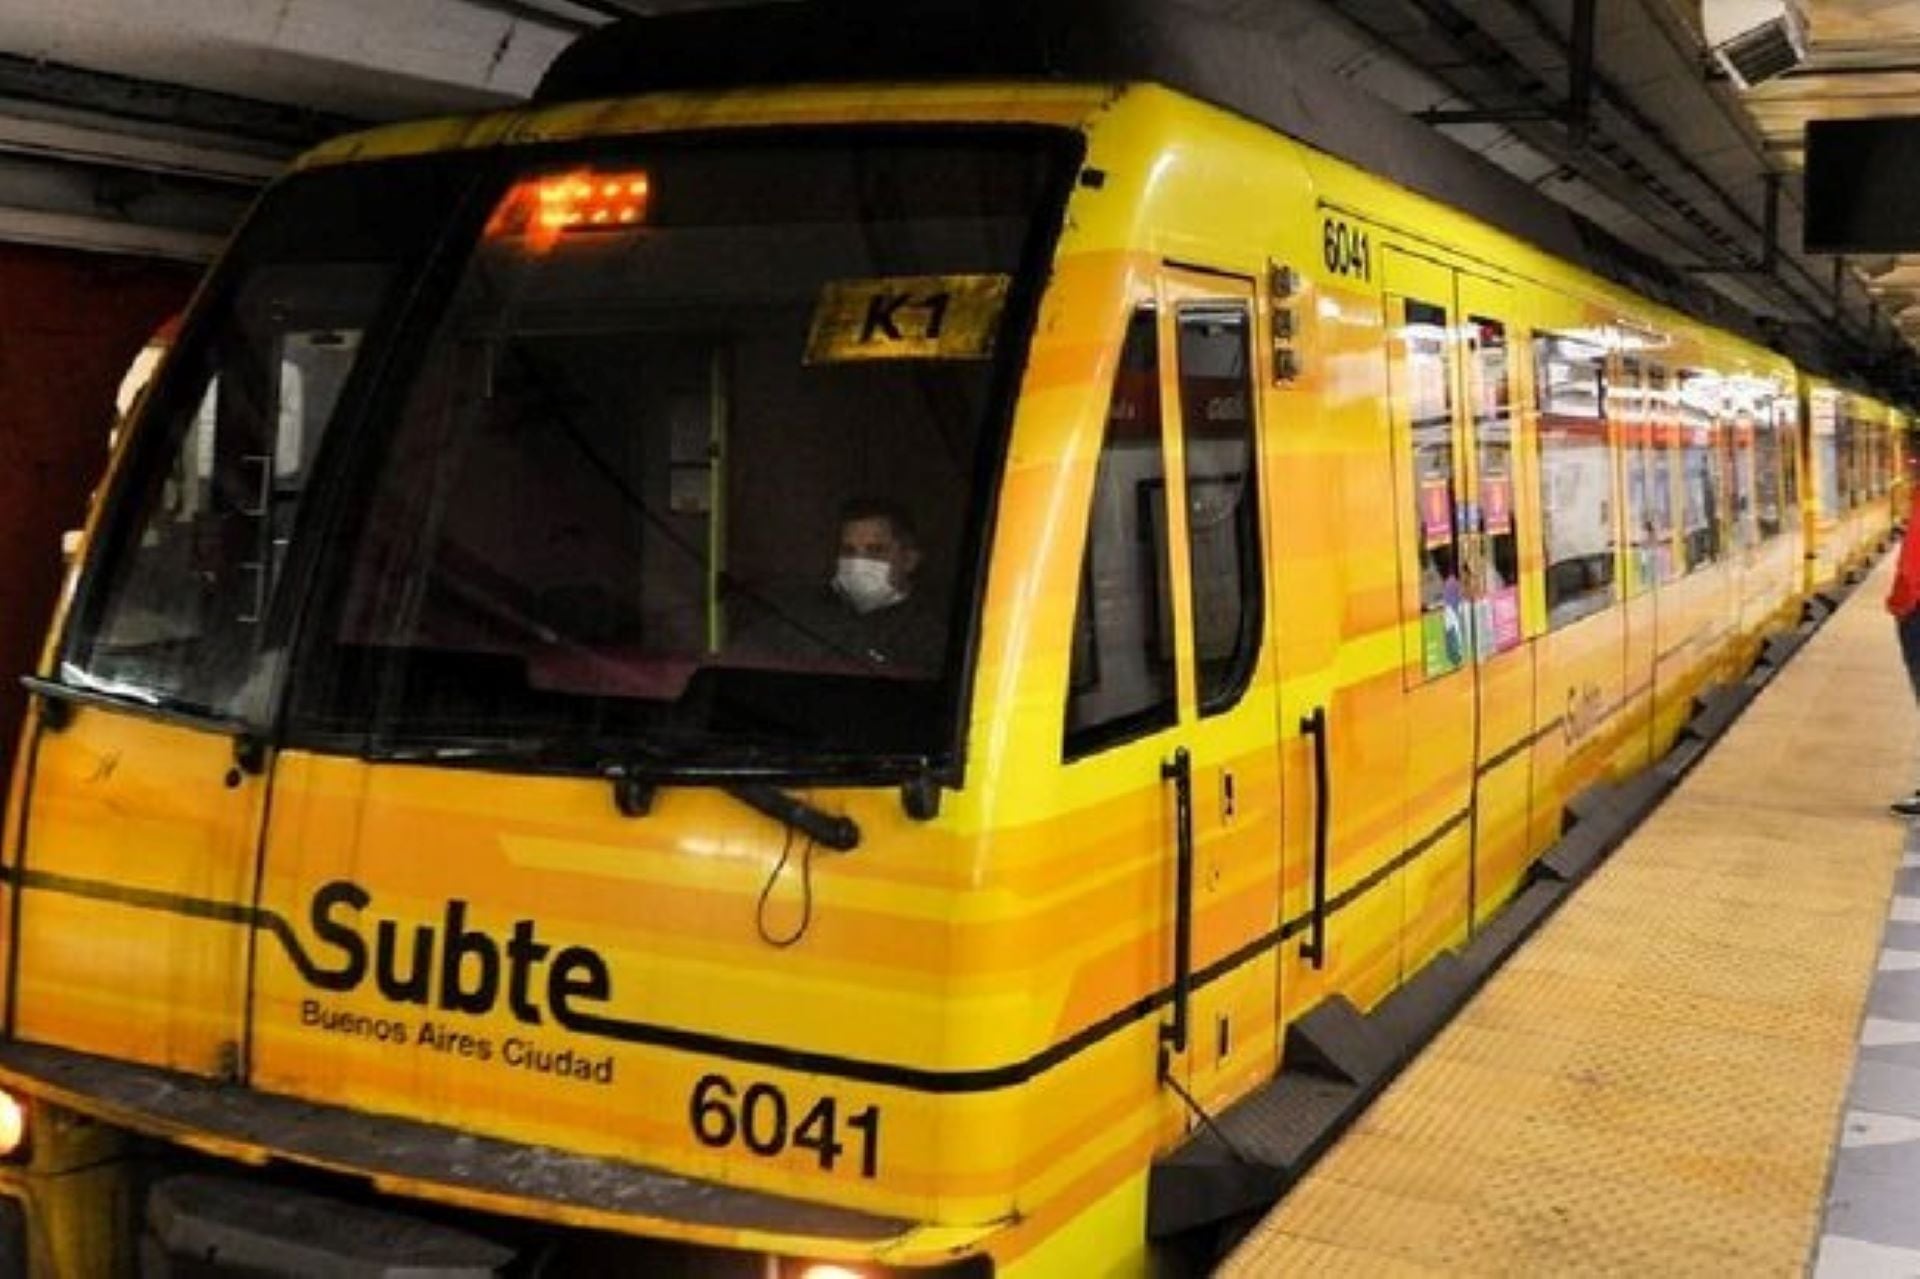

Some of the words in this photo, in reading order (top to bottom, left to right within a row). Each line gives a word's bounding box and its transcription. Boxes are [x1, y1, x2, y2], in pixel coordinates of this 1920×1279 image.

[1323, 217, 1371, 284] 6041
[304, 880, 611, 1032] Subte
[301, 998, 408, 1045] Buenos
[417, 1021, 492, 1062] Aires
[501, 1036, 615, 1085] Ciudad
[690, 1072, 880, 1180] 6041
